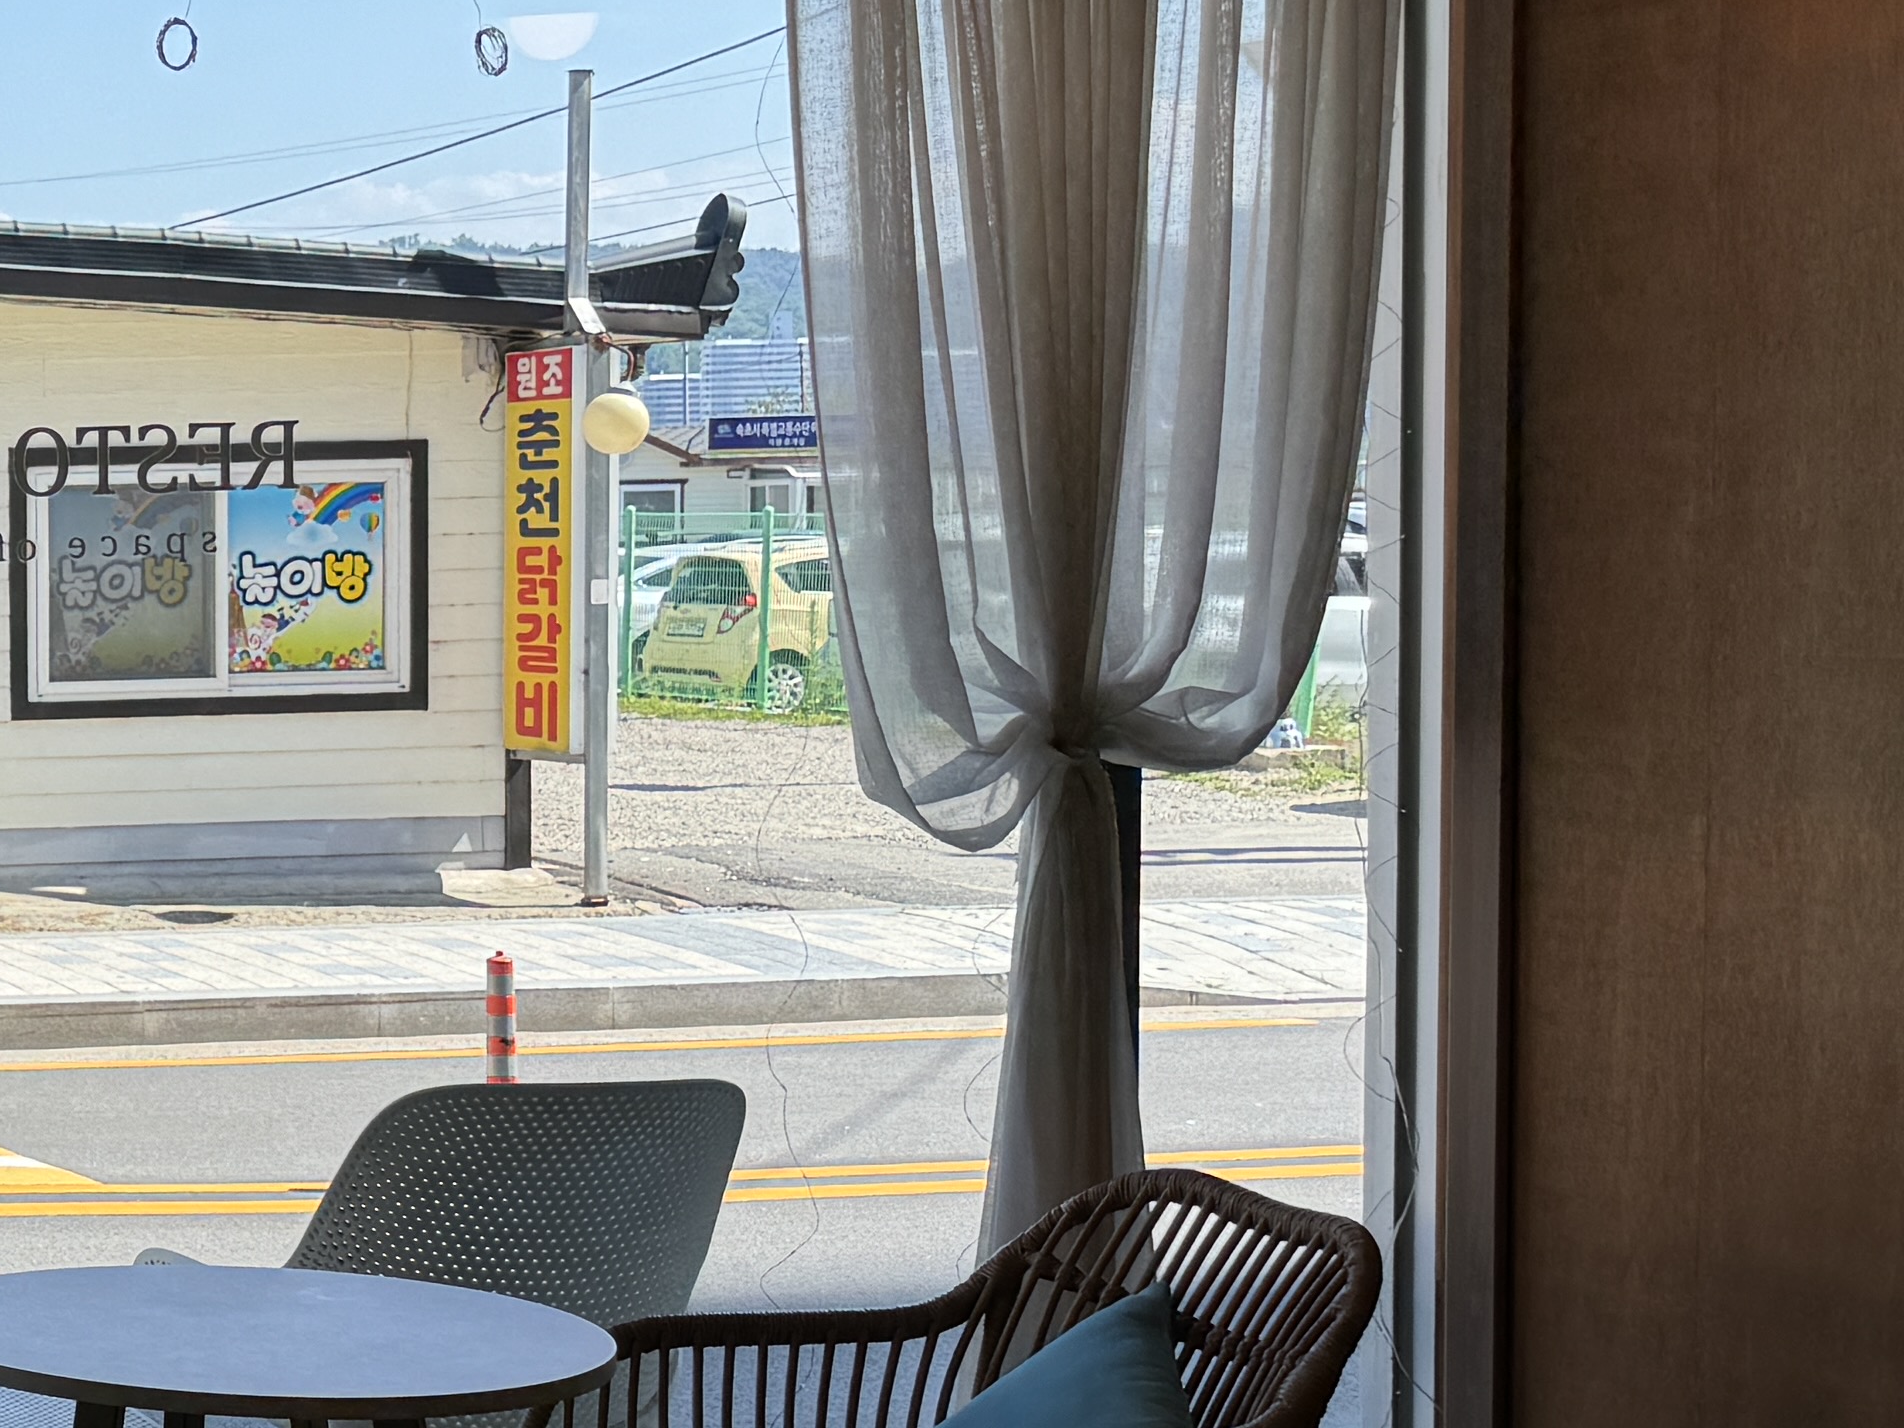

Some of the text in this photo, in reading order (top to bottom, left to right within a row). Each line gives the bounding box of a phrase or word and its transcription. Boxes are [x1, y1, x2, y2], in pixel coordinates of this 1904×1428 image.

[516, 354, 564, 397] 원조
[238, 550, 371, 605] 놀이방
[515, 408, 563, 743] 춘천닭갈비
